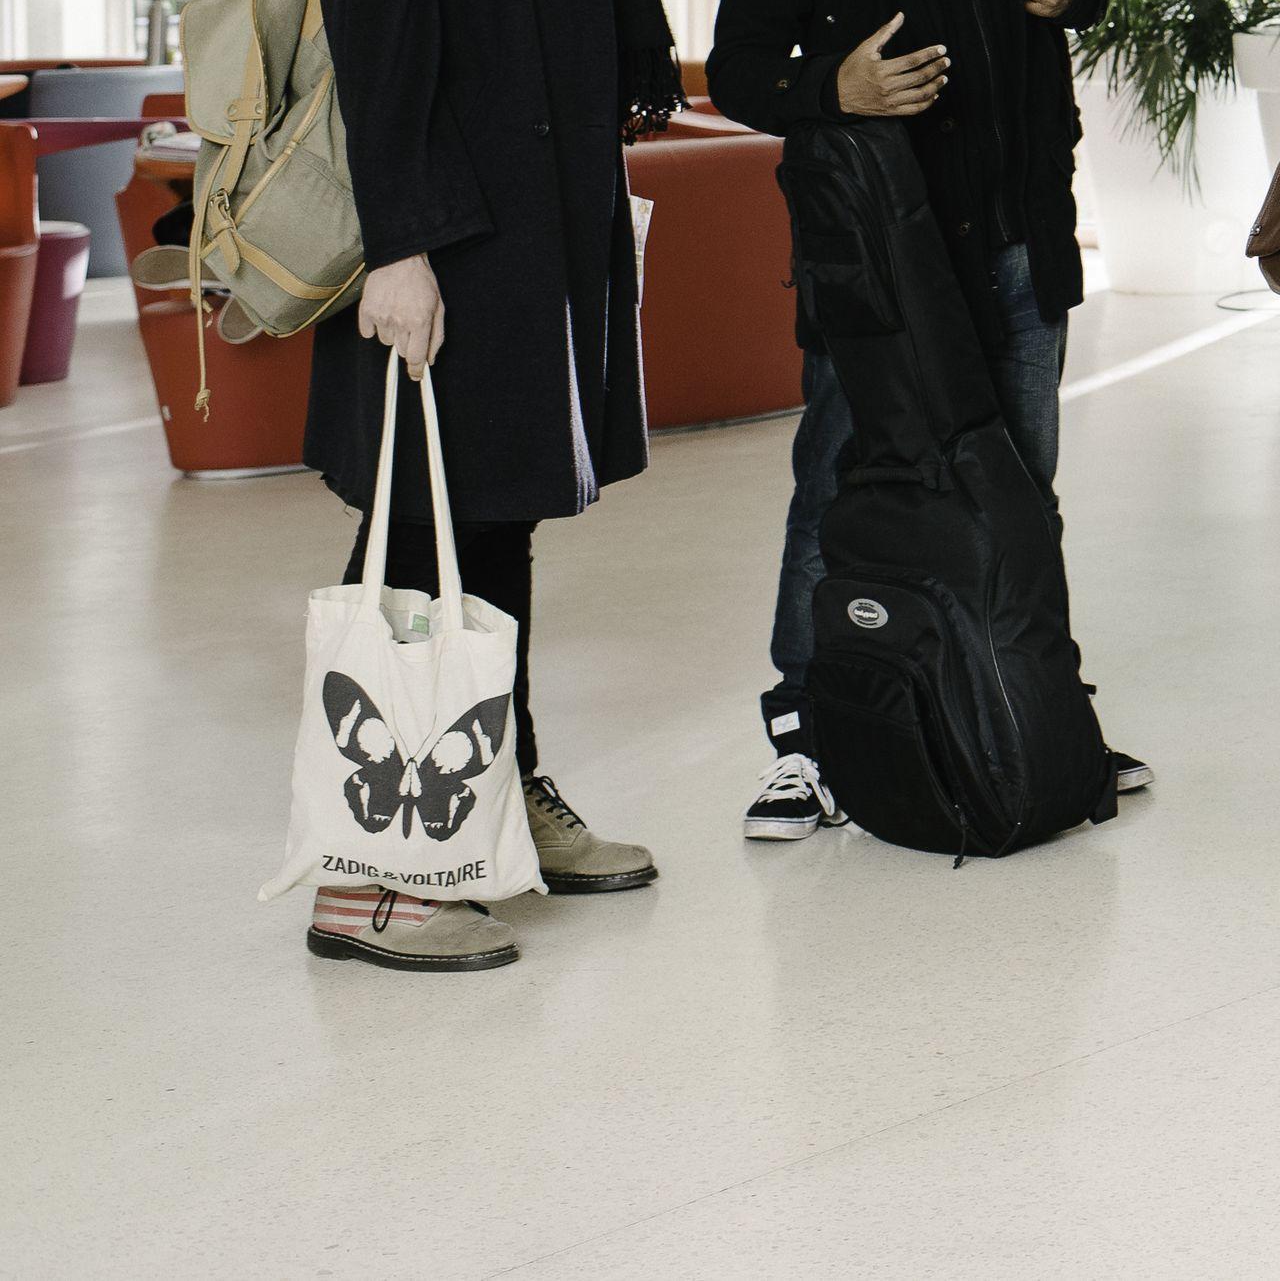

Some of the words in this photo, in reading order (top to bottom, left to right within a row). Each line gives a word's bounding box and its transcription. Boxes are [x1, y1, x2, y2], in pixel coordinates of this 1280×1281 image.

[322, 854, 380, 878] ZADIG
[382, 870, 398, 881] &
[400, 859, 487, 888] VOLTAIRE
